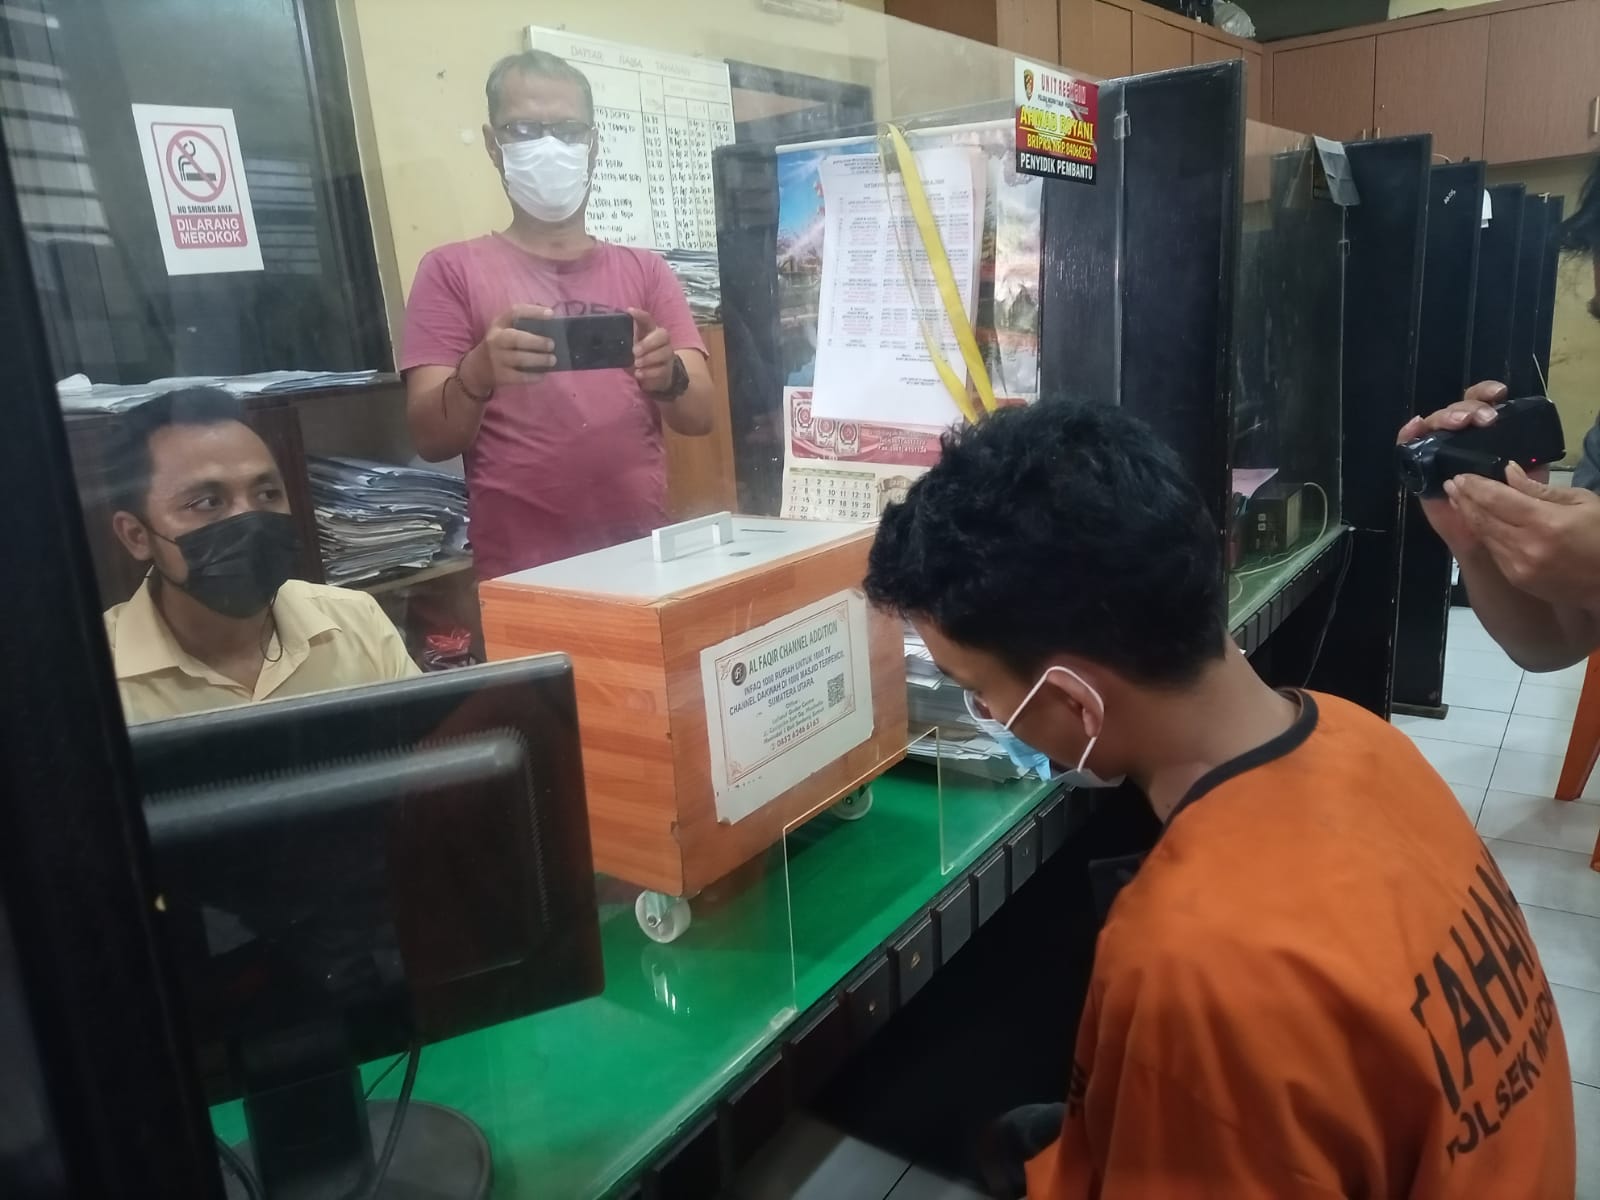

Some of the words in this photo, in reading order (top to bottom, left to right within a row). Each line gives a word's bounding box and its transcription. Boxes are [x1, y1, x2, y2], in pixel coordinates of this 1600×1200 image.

[1041, 73, 1057, 95] UNIT
[1027, 133, 1052, 152] BRIPKA
[1020, 152, 1056, 173] PENYIDIK
[1056, 159, 1094, 180] PEMBANTU
[177, 205, 187, 214] NO
[187, 204, 217, 214] SMOKING
[217, 204, 233, 213] AREA
[176, 217, 240, 231] DILARANG
[180, 230, 242, 244] MEROKOK
[828, 489, 836, 497] 10
[840, 490, 847, 498] 11
[851, 491, 859, 499] 12
[863, 492, 871, 500] 13
[828, 498, 835, 506] 17
[838, 509, 847, 517] 25
[850, 510, 858, 518] 26
[749, 658, 758, 675] AL
[758, 648, 779, 671] FAQIR
[779, 636, 809, 658] CHANNEL
[809, 619, 838, 645] ADDITION
[744, 679, 762, 697] INFAQ
[762, 673, 774, 687] 1000
[775, 663, 795, 682] RUPIAH
[795, 654, 813, 672] UNTUK
[824, 645, 832, 655] TV
[729, 695, 757, 716] CHANNEL
[757, 682, 782, 704] DAKWAH
[781, 680, 788, 690] DI
[788, 673, 799, 686] 1000
[800, 663, 819, 682] MASJID
[818, 650, 845, 672] TERPENCIL
[767, 684, 797, 708] SUMATERA
[797, 676, 815, 692] UTARA
